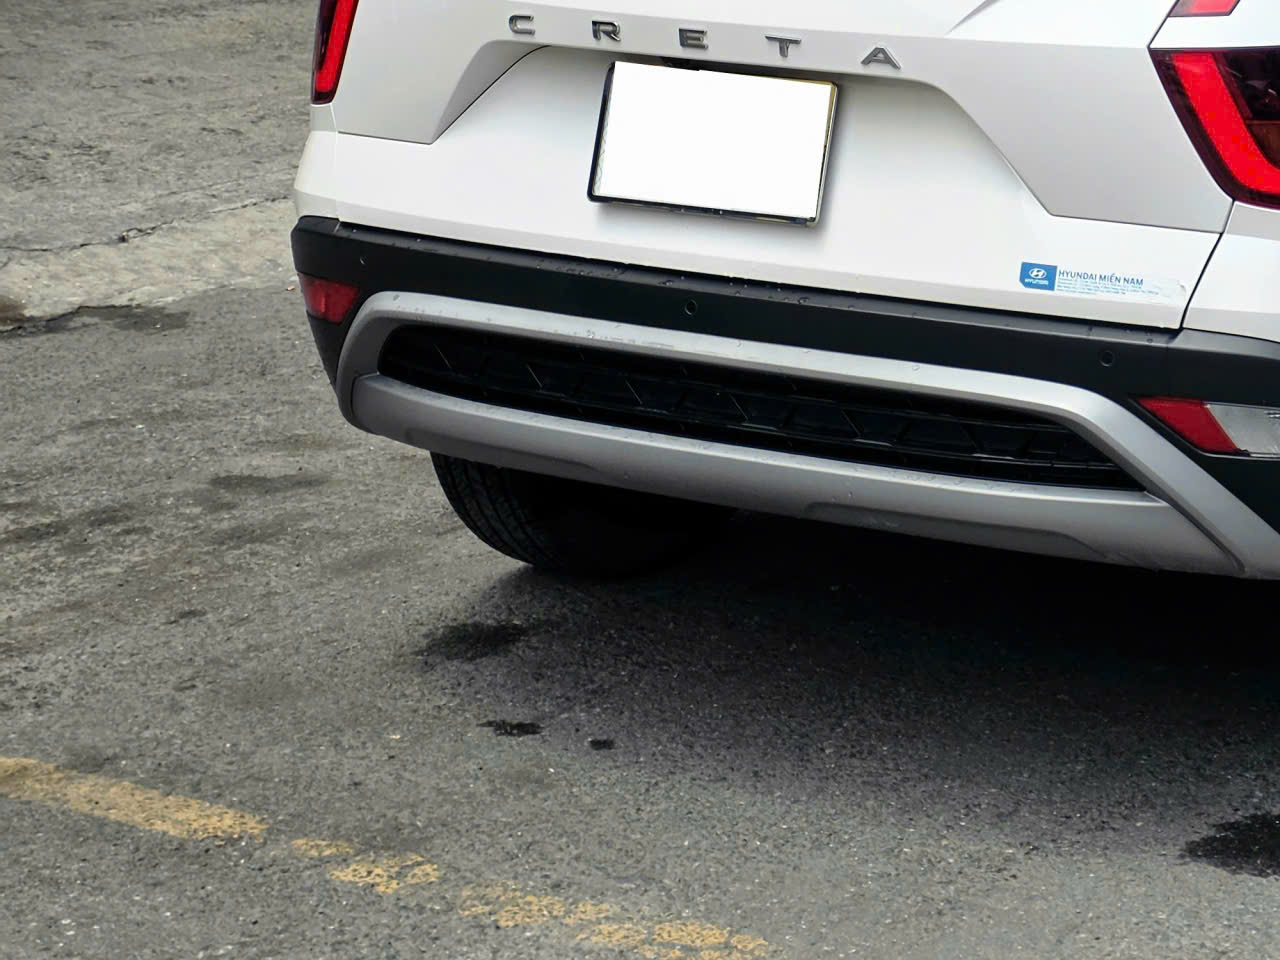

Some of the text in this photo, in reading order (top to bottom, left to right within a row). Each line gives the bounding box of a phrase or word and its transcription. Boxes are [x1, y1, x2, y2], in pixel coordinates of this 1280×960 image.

[509, 14, 901, 69] CRETA
[1057, 269, 1098, 281] HYUNDAI
[1123, 276, 1144, 287] NAM
